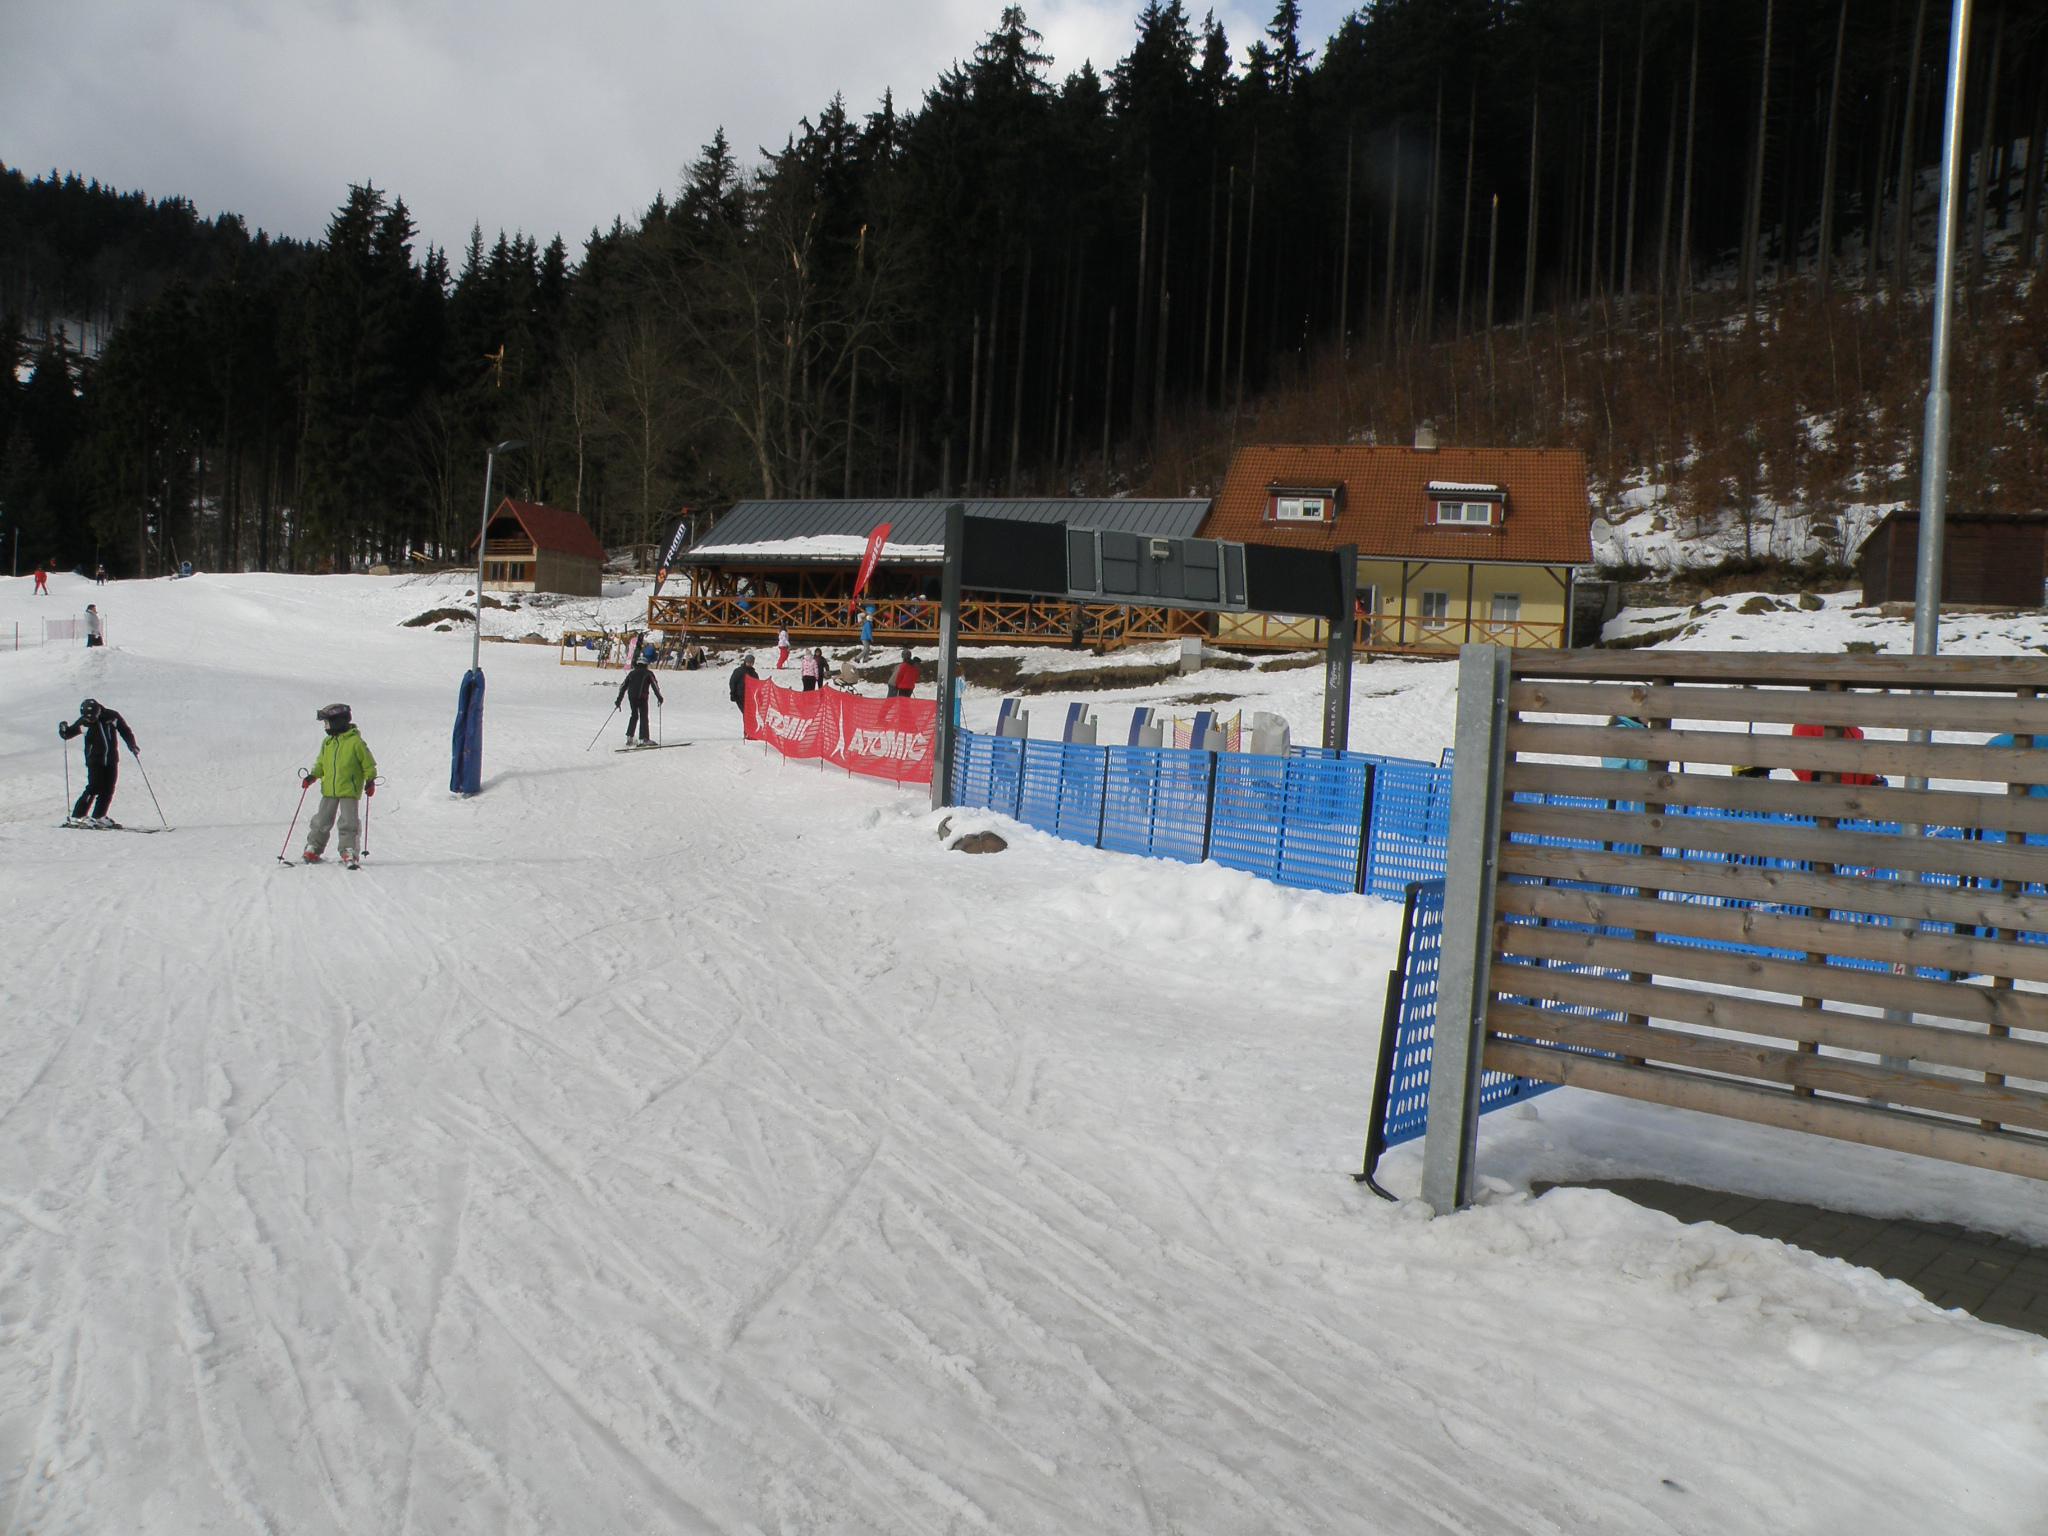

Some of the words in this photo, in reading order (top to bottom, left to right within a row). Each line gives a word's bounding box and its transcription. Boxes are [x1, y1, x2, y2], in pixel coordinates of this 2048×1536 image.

[664, 523, 684, 567] TRIMM
[765, 706, 812, 741] ATOMIC
[848, 728, 928, 761] ATOMIC
